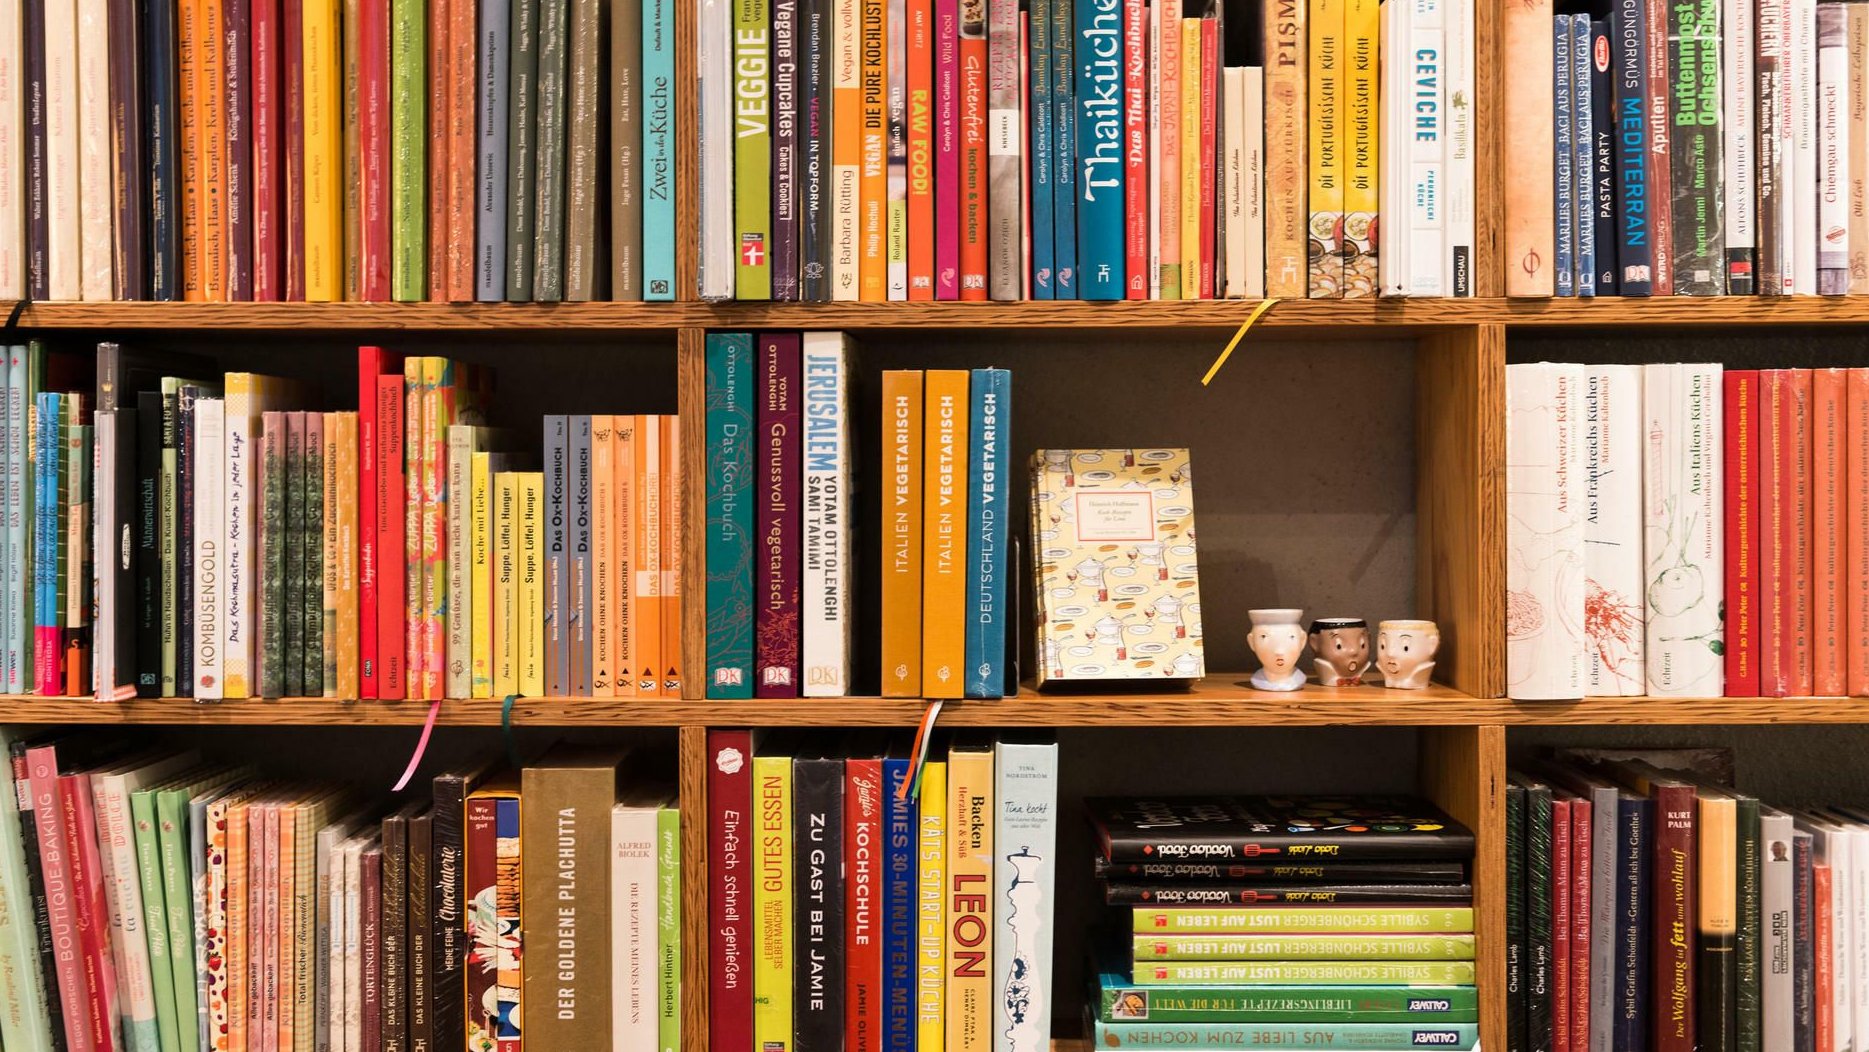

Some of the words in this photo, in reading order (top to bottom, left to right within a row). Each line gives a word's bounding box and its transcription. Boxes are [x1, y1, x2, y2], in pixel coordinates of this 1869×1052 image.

[775, 2, 794, 57] Vegane
[866, 1, 881, 66] KOCHLUST
[942, 15, 952, 39] Food
[942, 42, 952, 63] Wild
[1557, 33, 1568, 86] PERUGIA
[1675, 3, 1696, 126] Buttenmost
[206, 68, 216, 91] und
[738, 28, 766, 138] VEGGIE
[775, 63, 795, 136] Cupcakes
[866, 70, 881, 104] PURE
[943, 71, 951, 100] Caldicott
[963, 56, 984, 142] Glutenfrei
[1416, 49, 1436, 142] CEVICHE
[206, 94, 216, 128] Krebs
[650, 77, 666, 134] Küche
[810, 97, 819, 136] VEGAN
[866, 108, 881, 128] DIE
[891, 87, 901, 122] vegan
[913, 90, 928, 132] RAW
[1083, 0, 1119, 201] Thaiküche
[1558, 90, 1568, 110] AUS
[1825, 86, 1836, 140] schmeckt
[892, 126, 901, 156] einfach
[943, 128, 952, 152] Carolyn
[1559, 115, 1569, 143] BACI
[1652, 97, 1668, 154] Apulien
[1695, 134, 1705, 156] Aste
[207, 133, 219, 183] Karpfen,
[780, 147, 789, 171] Cakes
[810, 140, 818, 152] IN
[866, 135, 881, 177] VEGAN
[1599, 132, 1610, 172] PARTY
[650, 158, 666, 200] Zwei
[809, 154, 819, 210] TOPFORM
[913, 140, 928, 194] FOOD!
[968, 148, 977, 189] kochen
[1559, 151, 1569, 199] BURGET
[1623, 98, 1645, 245] MEDITERRAN
[1695, 159, 1705, 188] Marco
[1825, 144, 1837, 203] Chiemgau
[779, 182, 788, 215] Cookies
[840, 170, 854, 213] Rütting
[1600, 178, 1611, 218] PASTA
[1696, 197, 1706, 223] Jenni
[207, 198, 218, 227] Haas
[867, 201, 878, 232] Hochuli
[968, 204, 977, 244] backen
[1559, 202, 1570, 254] MARLIES
[208, 230, 220, 291] Breunlich,
[840, 218, 852, 264] Barbara
[867, 234, 881, 257] Philip
[1696, 227, 1706, 256] Martin
[1457, 256, 1465, 292] UMSCHAU
[807, 355, 837, 470] JERUSALEM
[1556, 377, 1567, 423] Küchen
[1587, 376, 1597, 422] Küchen
[389, 386, 399, 453] Suppenkochbuch
[724, 424, 737, 453] Das
[772, 423, 786, 511] Genussvoll
[896, 396, 908, 505] VEGETARISCH
[983, 394, 996, 503] VEGETARISCH
[1556, 426, 1567, 487] Schweizer
[1587, 426, 1597, 498] Frankreichs
[501, 487, 512, 519] Hunger
[723, 461, 737, 540] Kochbuch
[808, 476, 820, 511] SAMI
[825, 476, 837, 524] YOTAM
[1556, 490, 1567, 513] Aus
[1587, 502, 1598, 524] Aus
[501, 523, 512, 550] Löffel,
[808, 517, 820, 569] TAMIMI
[896, 513, 908, 572] ITALIEN
[501, 553, 512, 583] Suppe,
[768, 519, 785, 609] vegetarisch
[825, 530, 837, 620] OTTOLENGHI
[981, 509, 993, 623] DEUTSCHLAND
[200, 541, 215, 667] KOMBÜSENGOLD
[764, 776, 782, 831] ESSEN
[972, 796, 984, 848] Backen
[39, 793, 59, 861] BAKING
[724, 810, 739, 868] Einfach
[810, 814, 825, 841] ZU
[1558, 820, 1567, 844] Tisch
[558, 808, 575, 900] PLACHUTTA
[764, 837, 782, 892] GUTES
[1158, 845, 1188, 858] Food
[1190, 844, 1235, 857] Voodoo
[1560, 847, 1567, 858] zu
[439, 846, 455, 921] Chocolaterie
[810, 850, 825, 902] GAST
[857, 823, 868, 945] KOCHSCHULE
[1558, 860, 1567, 885] Mann
[1672, 848, 1686, 901] wohlauf
[49, 868, 74, 961] BOUTIQUE
[724, 876, 737, 920] schnell
[1558, 888, 1567, 924] Thomas
[1674, 904, 1685, 919] und
[445, 927, 453, 947] FEINE
[765, 900, 773, 960] LEBENSMITTEL
[775, 900, 783, 937] MACHEN
[810, 910, 824, 941] BEI
[953, 875, 986, 977] LEON
[1177, 916, 1217, 926] LEBEN
[1221, 915, 1245, 926] AUF
[1250, 915, 1280, 925] LUST
[1558, 926, 1567, 940] Bei
[1671, 922, 1687, 947] fett
[364, 924, 375, 1004] TORTENGLÜCK
[445, 949, 453, 970] MEINE
[558, 908, 575, 980] GOLDENE
[665, 944, 674, 979] Hintner
[721, 926, 737, 989] genießen
[775, 939, 783, 969] SELBER
[1510, 945, 1518, 963] Lamb
[1674, 950, 1685, 959] ist
[810, 951, 823, 1010] JAMIE
[1510, 965, 1518, 992] Charles
[1672, 961, 1686, 1020] Wolfgang
[558, 988, 575, 1019] DER
[665, 981, 674, 1017] Herbert
[1128, 1032, 1198, 1043] KOCHEN
[1208, 1032, 1244, 1043] ZUM
[1253, 1031, 1296, 1043] LIEBE
[1304, 1032, 1334, 1043] AUS
[1675, 1022, 1686, 1037] Der
